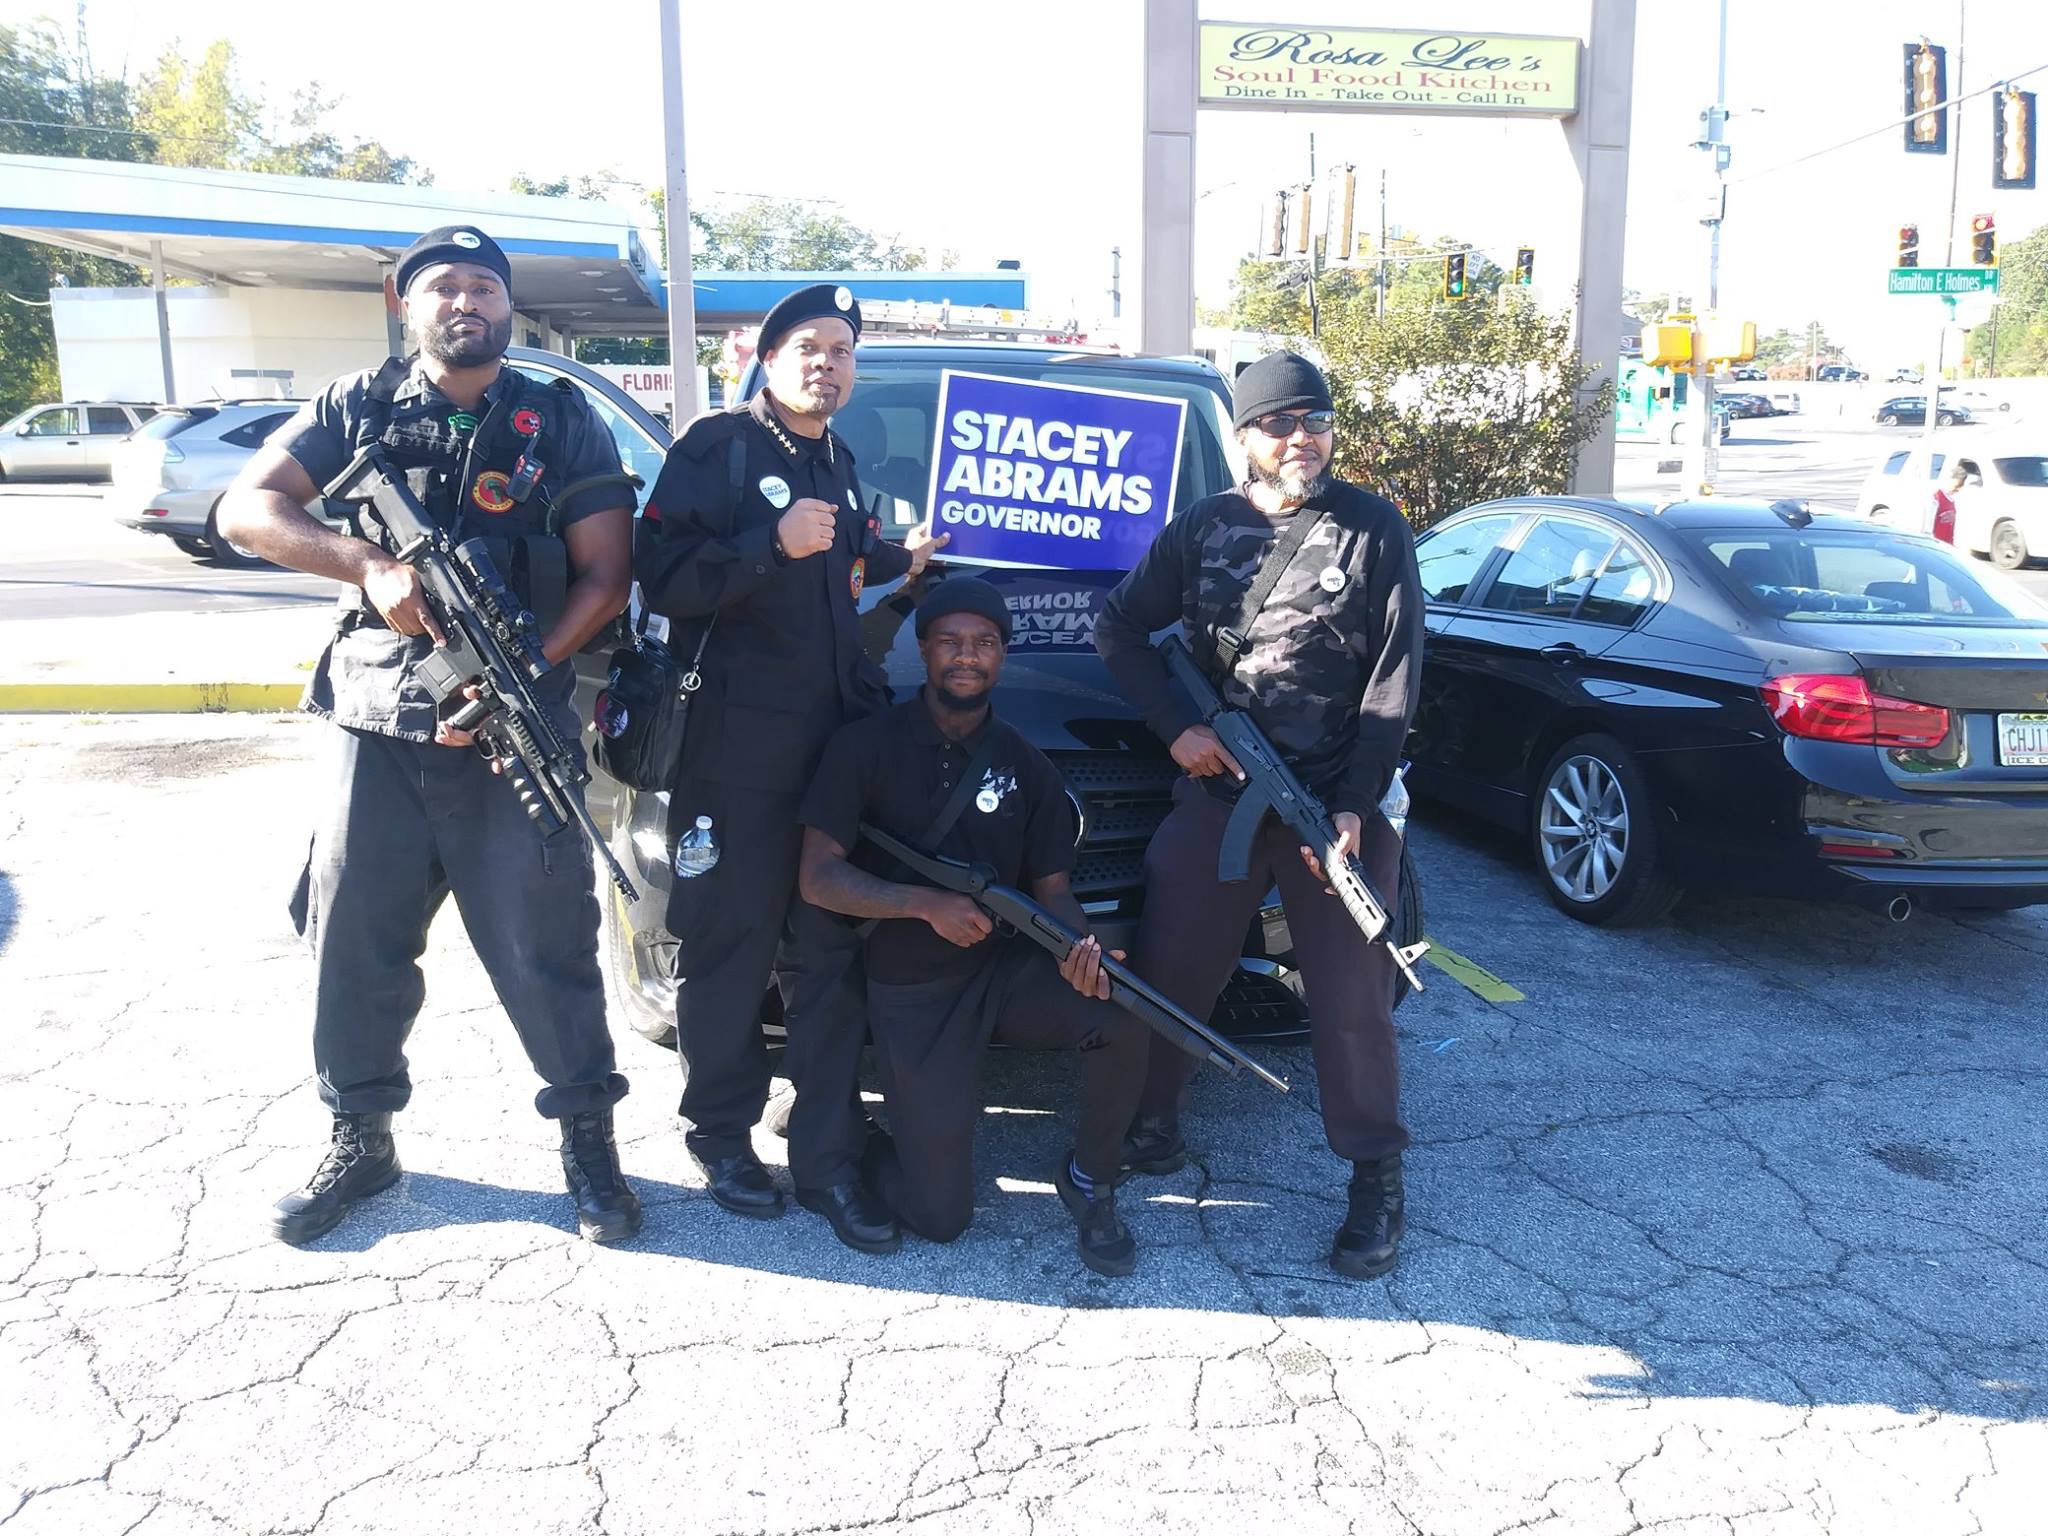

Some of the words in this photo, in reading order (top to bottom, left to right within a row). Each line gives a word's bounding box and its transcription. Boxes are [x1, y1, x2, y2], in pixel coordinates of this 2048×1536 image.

[1229, 29, 1388, 66] Rosa
[1401, 36, 1543, 71] Lee's
[1214, 65, 1296, 83] Soul
[1311, 68, 1402, 87] Food
[1418, 72, 1552, 92] Kitchen
[1225, 85, 1277, 98] Dine
[1286, 87, 1307, 98] In
[1331, 88, 1384, 100] Take
[1392, 90, 1433, 102] Out
[1457, 92, 1498, 104] Call
[1506, 94, 1526, 105] In
[1890, 272, 1933, 291] Hamilton
[1936, 272, 1943, 291] E
[1945, 272, 1980, 291] Holmes
[623, 373, 672, 391] FLORI
[950, 410, 1133, 468] STACEY
[943, 454, 1153, 515] ABRAMS
[941, 500, 1101, 540] GOVERNOR
[2007, 728, 2048, 752] CHJ1
